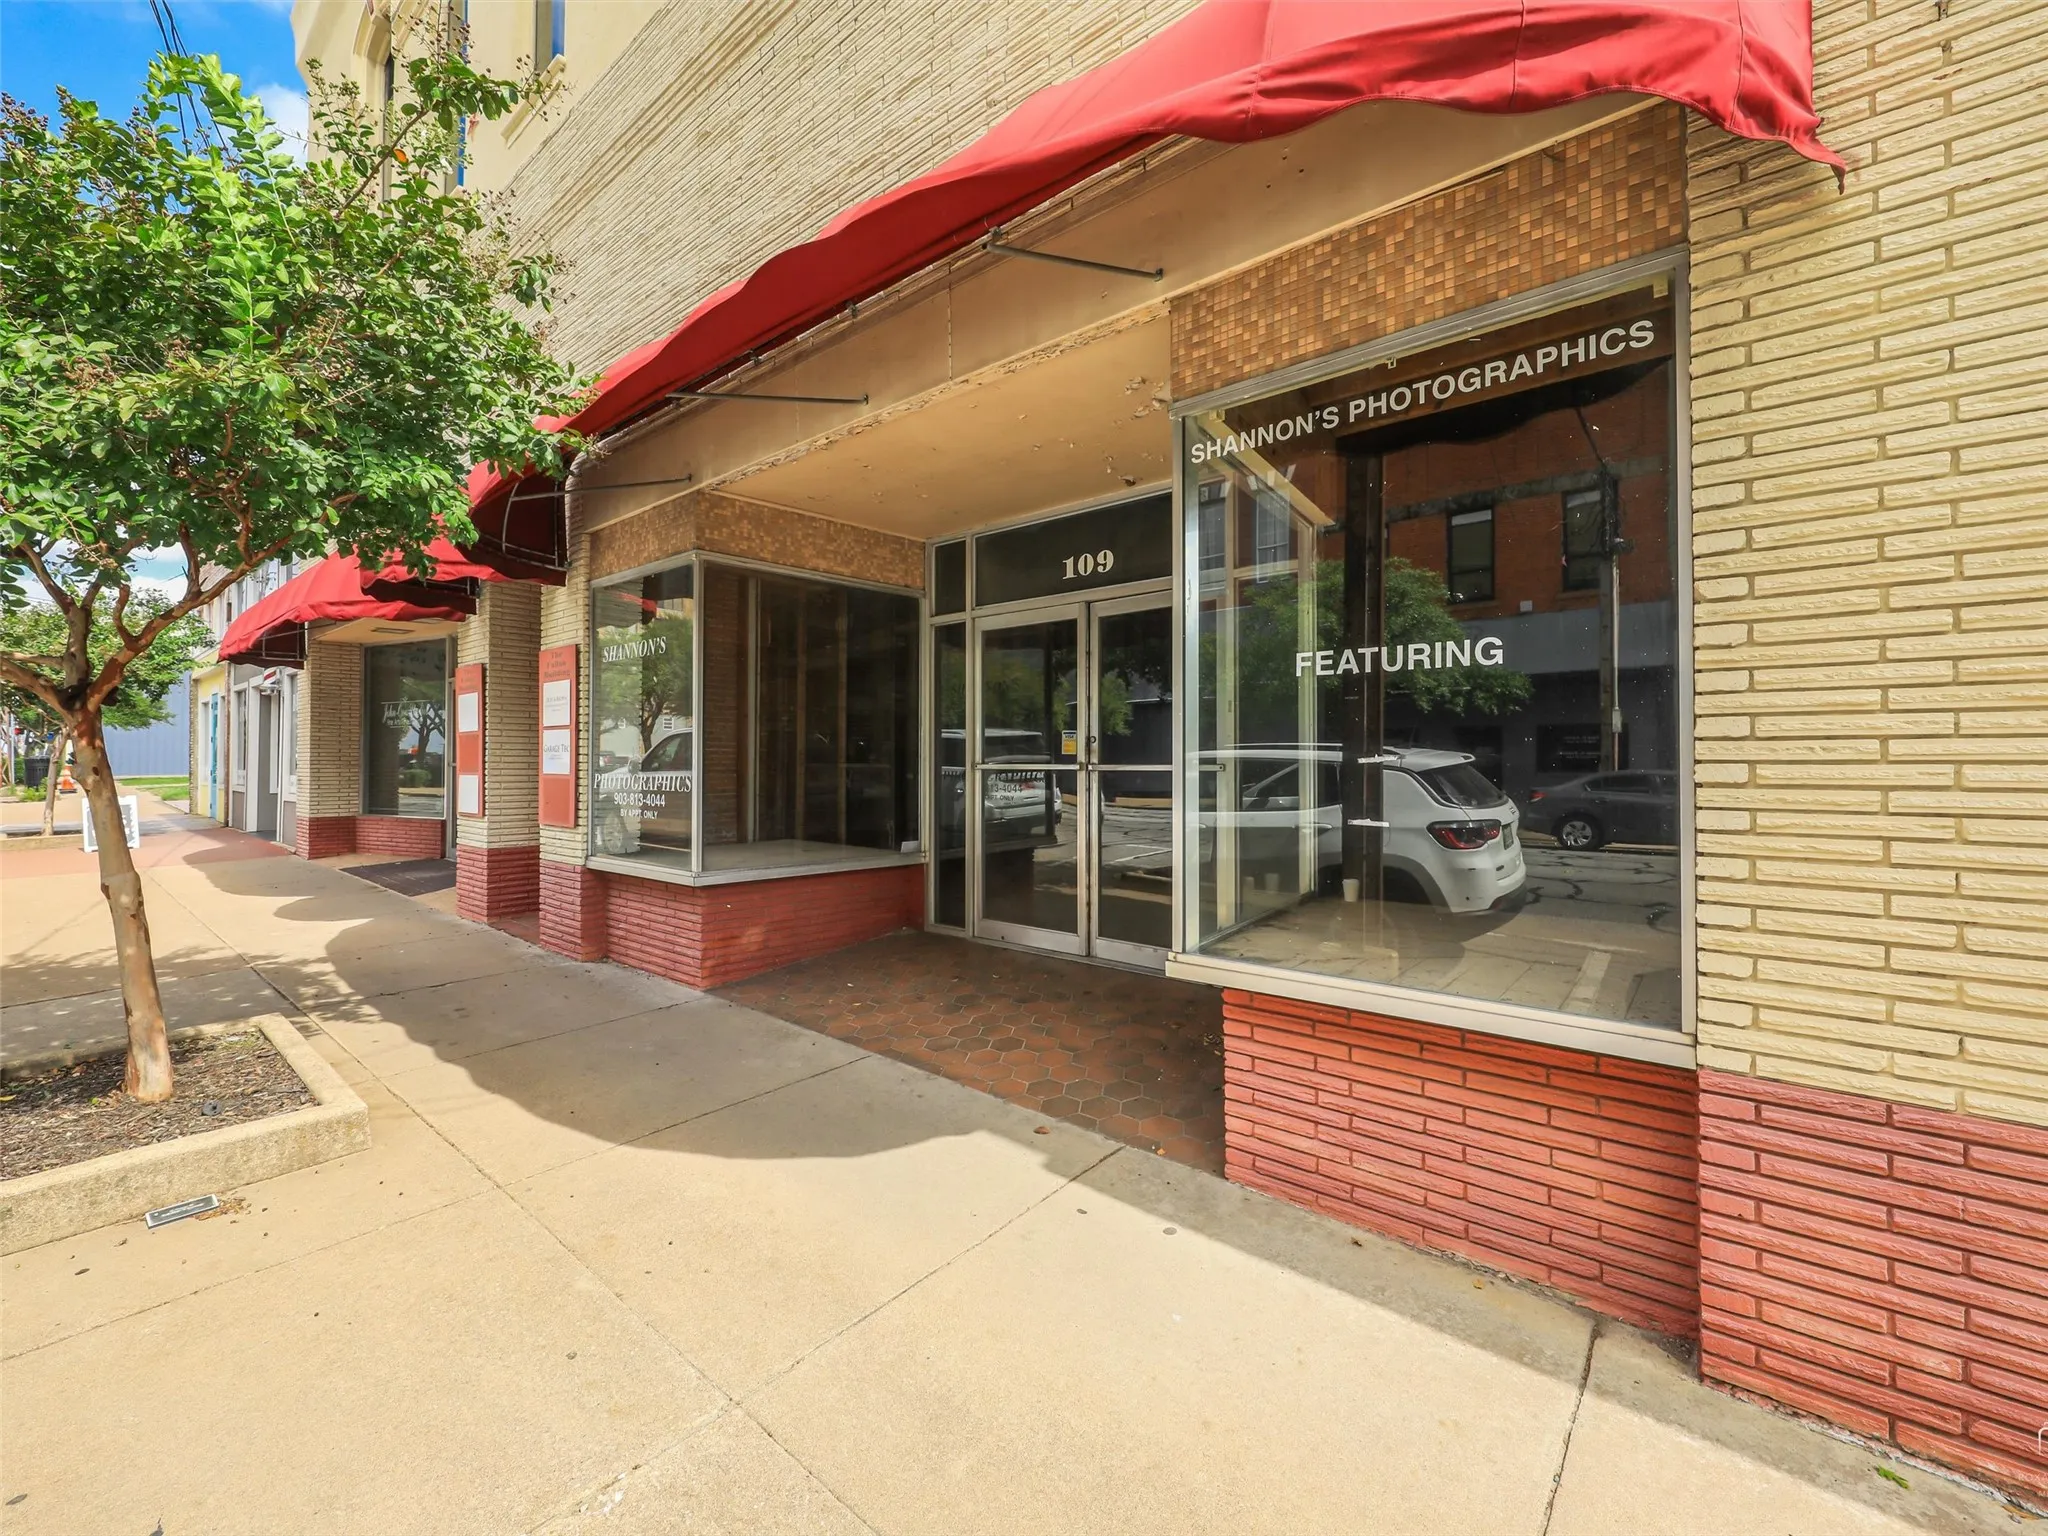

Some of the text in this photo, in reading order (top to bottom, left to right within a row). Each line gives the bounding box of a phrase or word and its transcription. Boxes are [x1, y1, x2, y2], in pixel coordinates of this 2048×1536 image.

[1191, 320, 1655, 464] SHANNON'S PHOTOGRAPHICS
[1062, 549, 1114, 580] 109
[602, 636, 667, 663] SHANNON'S
[1295, 636, 1504, 677] FEATURING
[593, 773, 692, 793] PHOTOGRAPHICS
[613, 792, 666, 808] 903-813-4044
[620, 808, 628, 817] BY
[643, 810, 659, 819] ONLY
